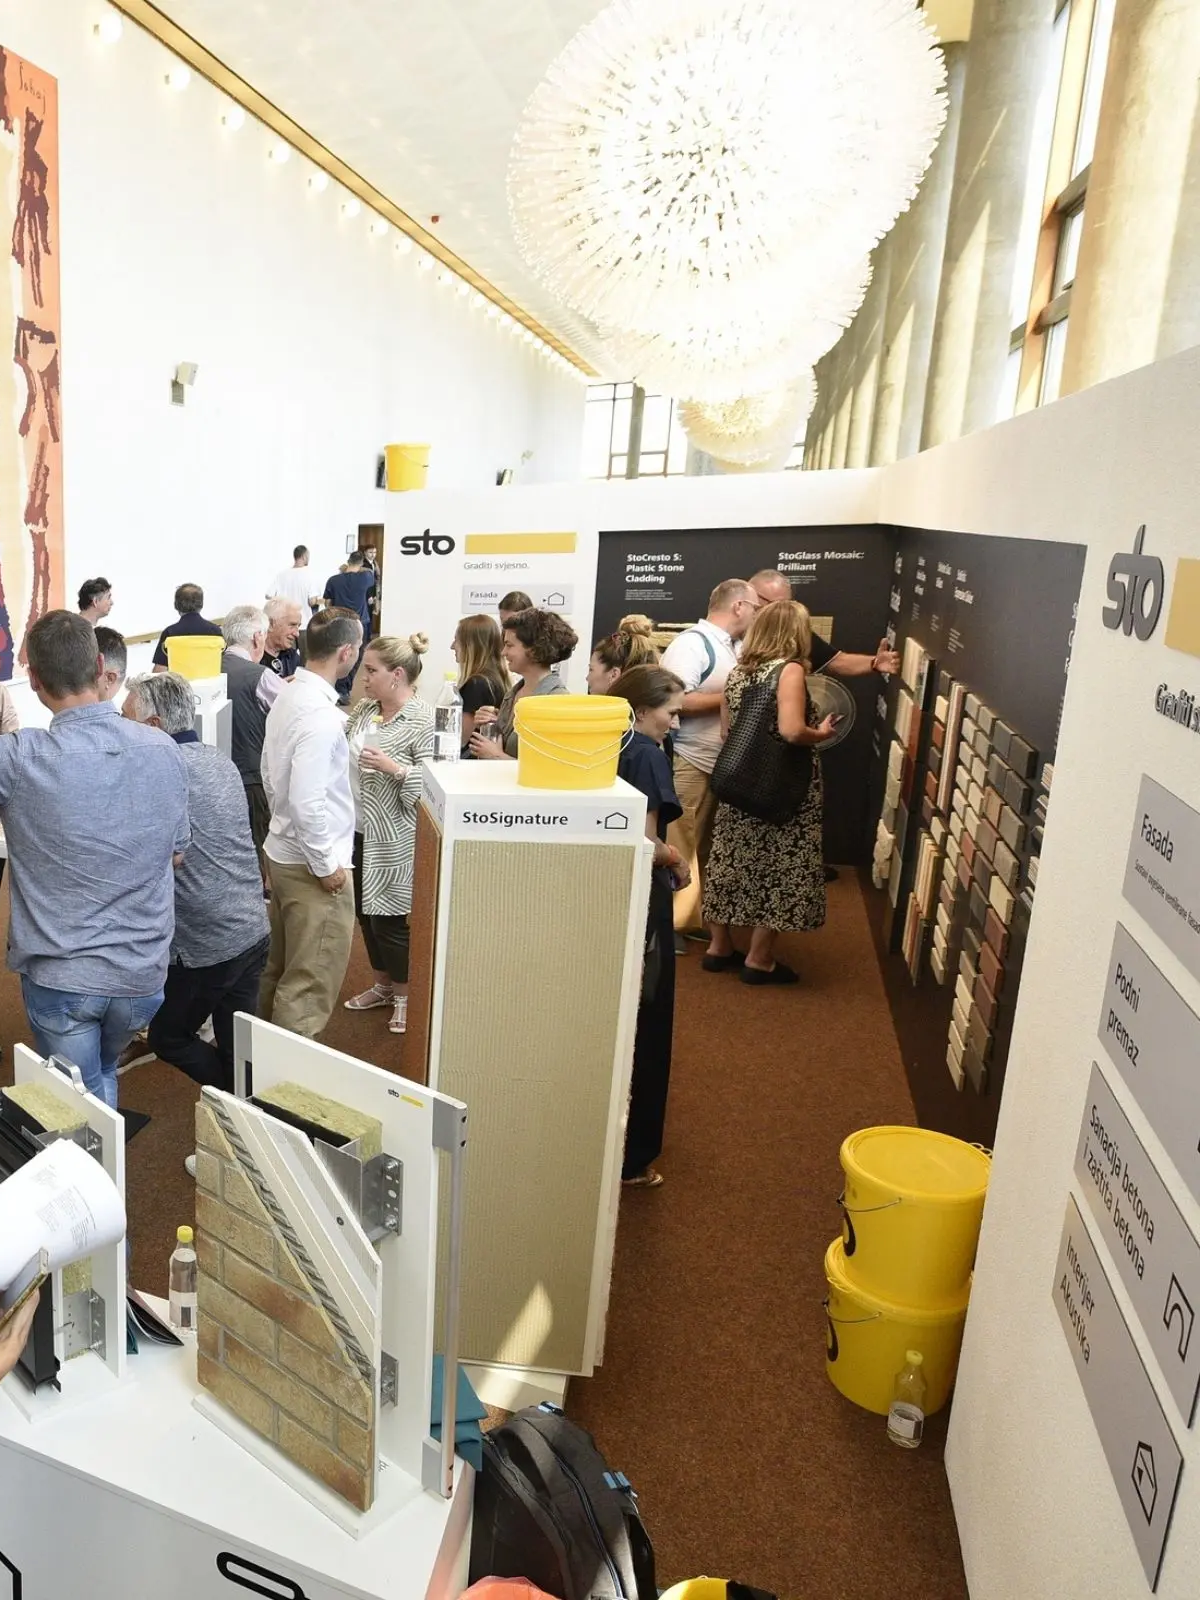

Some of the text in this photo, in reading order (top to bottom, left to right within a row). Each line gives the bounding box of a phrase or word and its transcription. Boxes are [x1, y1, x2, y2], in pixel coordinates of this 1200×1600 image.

[400, 528, 456, 556] sto
[778, 550, 865, 561] StoGlass Mosaic:
[463, 562, 531, 571] Graditi svjesno.
[626, 553, 671, 562] StoCresto
[626, 563, 685, 572] Plastic Stone
[776, 563, 817, 571] Brilliant
[625, 574, 665, 584] Cladding
[1102, 524, 1164, 641] sto
[470, 591, 498, 599] Fasada
[462, 811, 569, 828] StoSignature
[1140, 813, 1174, 863] Fasada
[1115, 962, 1141, 1013] Podni
[1106, 1007, 1140, 1067] premaz
[1090, 1104, 1155, 1245] Sanacija betona
[1083, 1136, 1145, 1280] i zaštita betona
[1066, 1235, 1095, 1316] Interijer
[1060, 1274, 1091, 1364] Akustika
